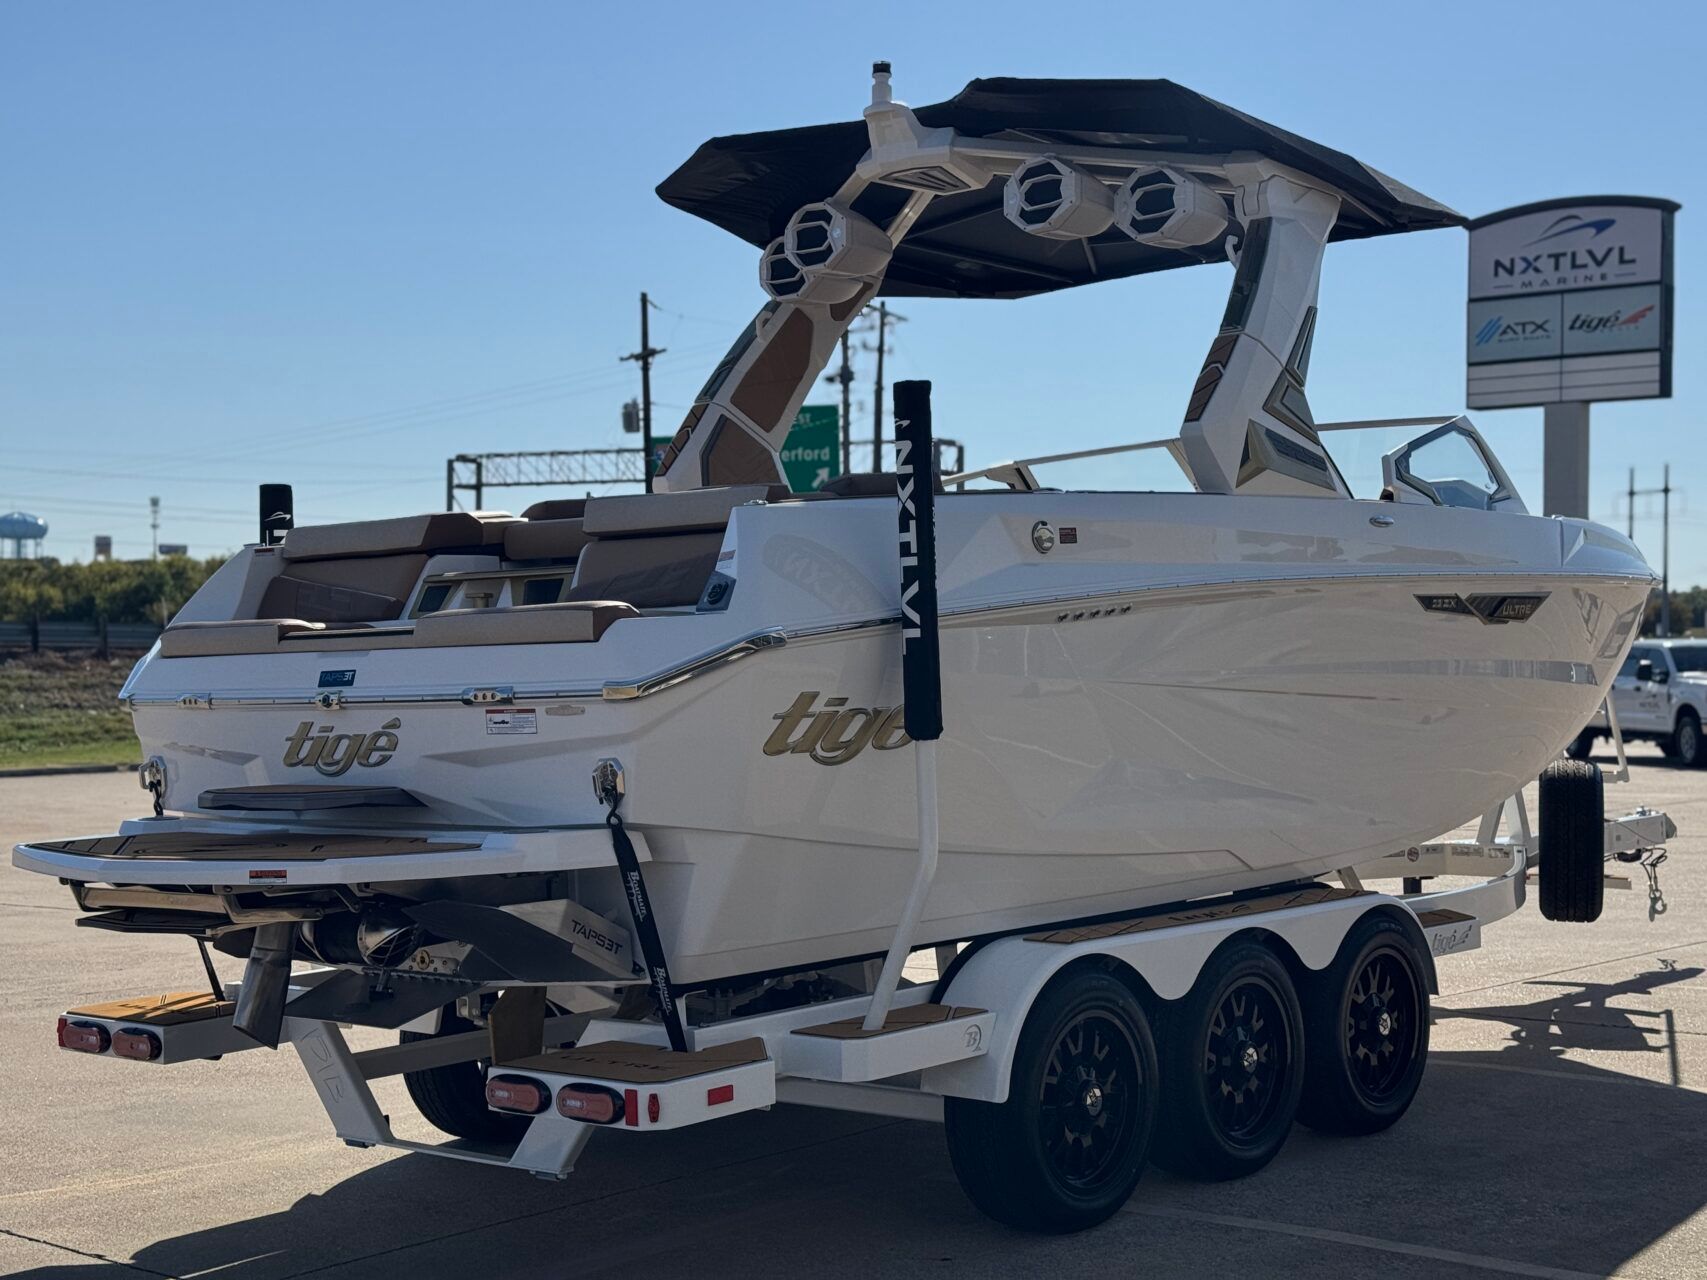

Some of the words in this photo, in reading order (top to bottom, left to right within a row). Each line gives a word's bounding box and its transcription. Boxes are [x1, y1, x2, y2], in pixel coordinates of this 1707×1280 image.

[1493, 246, 1637, 278] NXTLVL
[1520, 273, 1609, 289] MARINE
[1499, 319, 1549, 336] ATX
[1568, 310, 1621, 333] tigé
[781, 446, 830, 461] erford
[895, 439, 921, 656] NXTLVL
[283, 717, 401, 777] tigé
